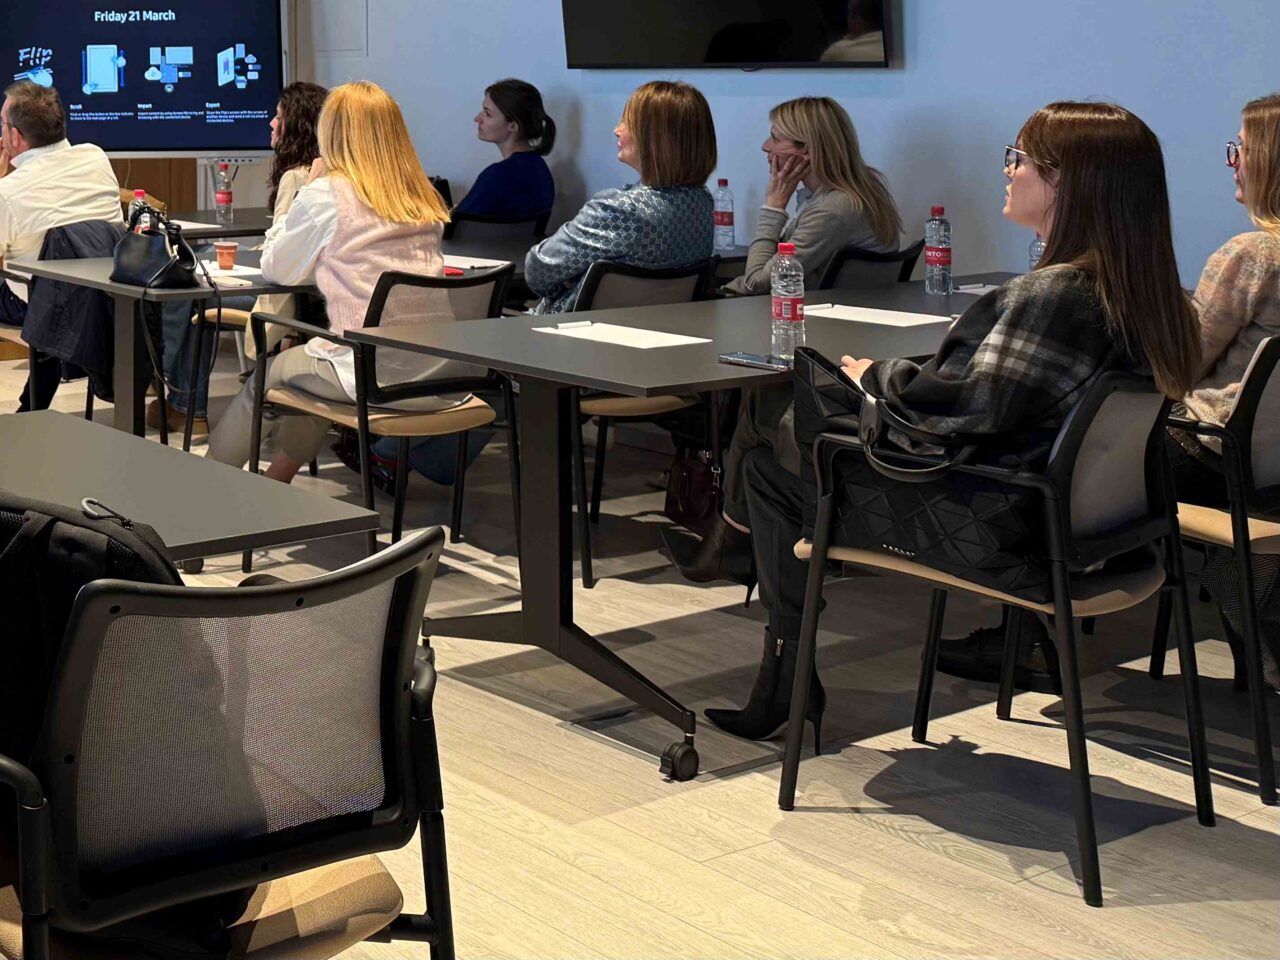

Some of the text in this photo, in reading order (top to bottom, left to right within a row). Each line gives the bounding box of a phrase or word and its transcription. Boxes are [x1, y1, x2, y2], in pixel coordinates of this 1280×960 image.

[94, 9, 176, 24] Friday 21 March
